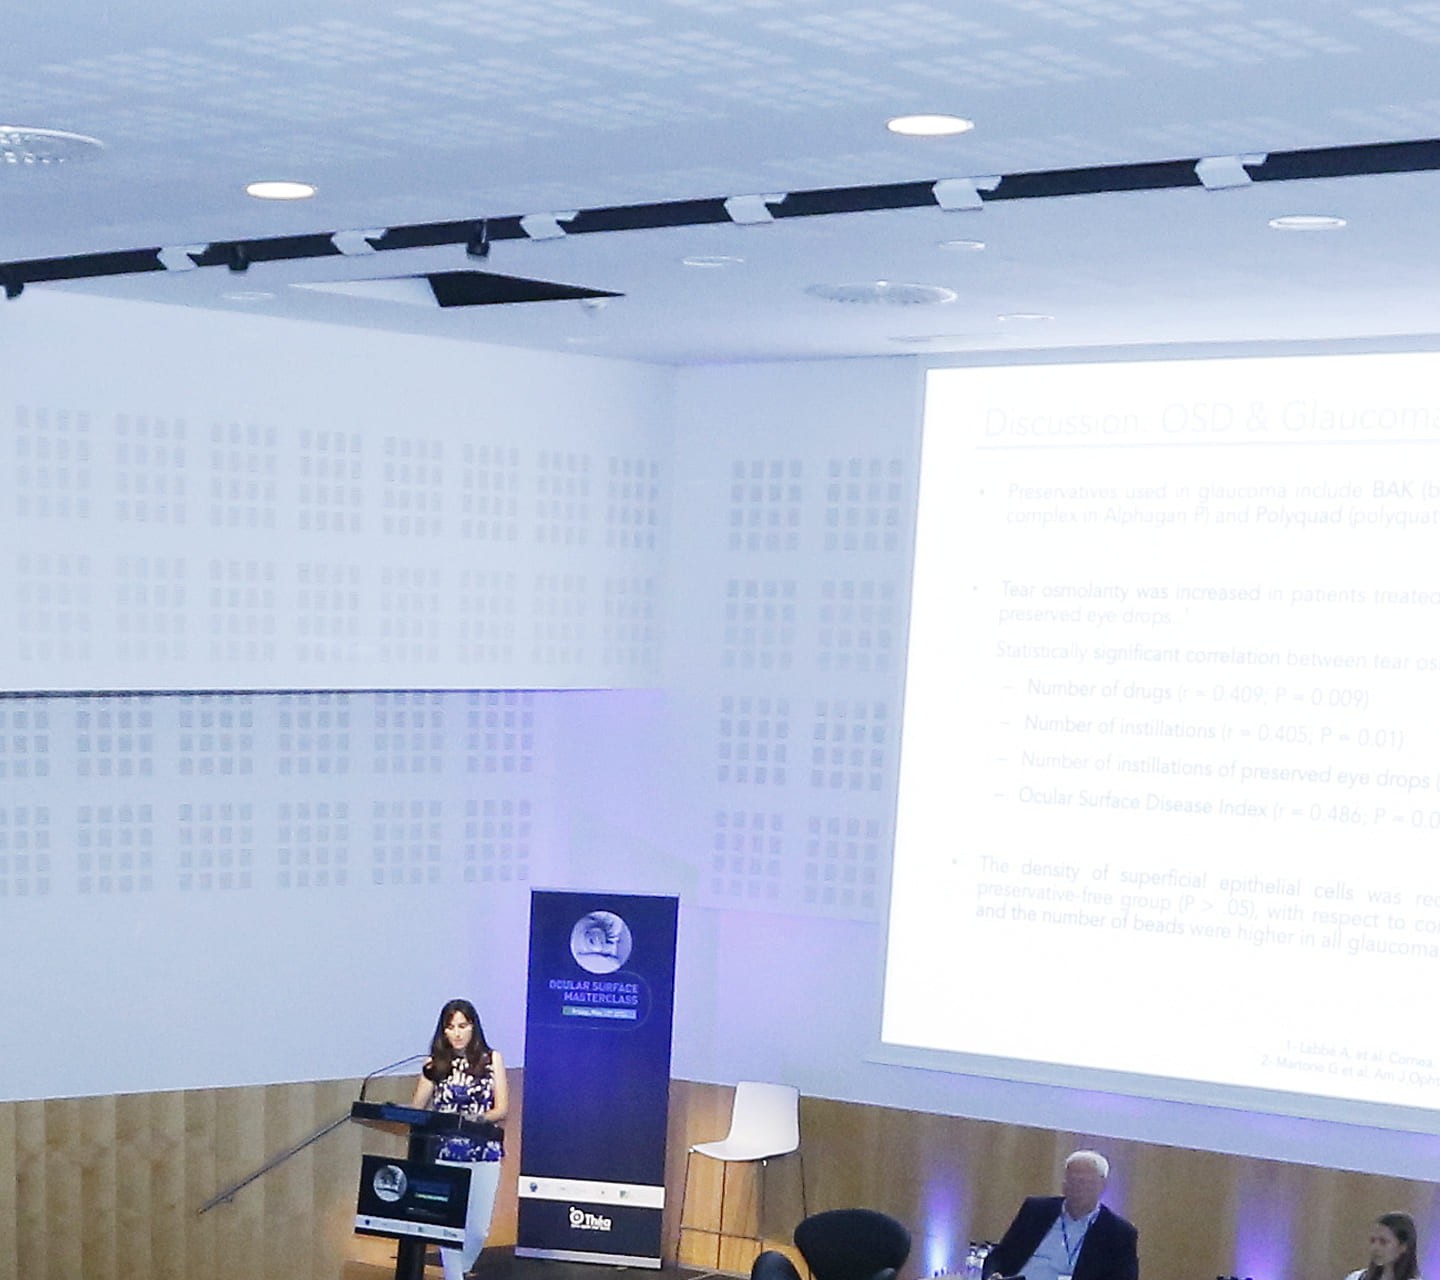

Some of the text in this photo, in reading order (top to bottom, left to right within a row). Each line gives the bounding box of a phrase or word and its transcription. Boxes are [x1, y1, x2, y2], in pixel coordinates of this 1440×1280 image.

[1161, 401, 1234, 433] OSD
[1245, 401, 1269, 433] &
[563, 991, 639, 1006] MASTERCLASS
